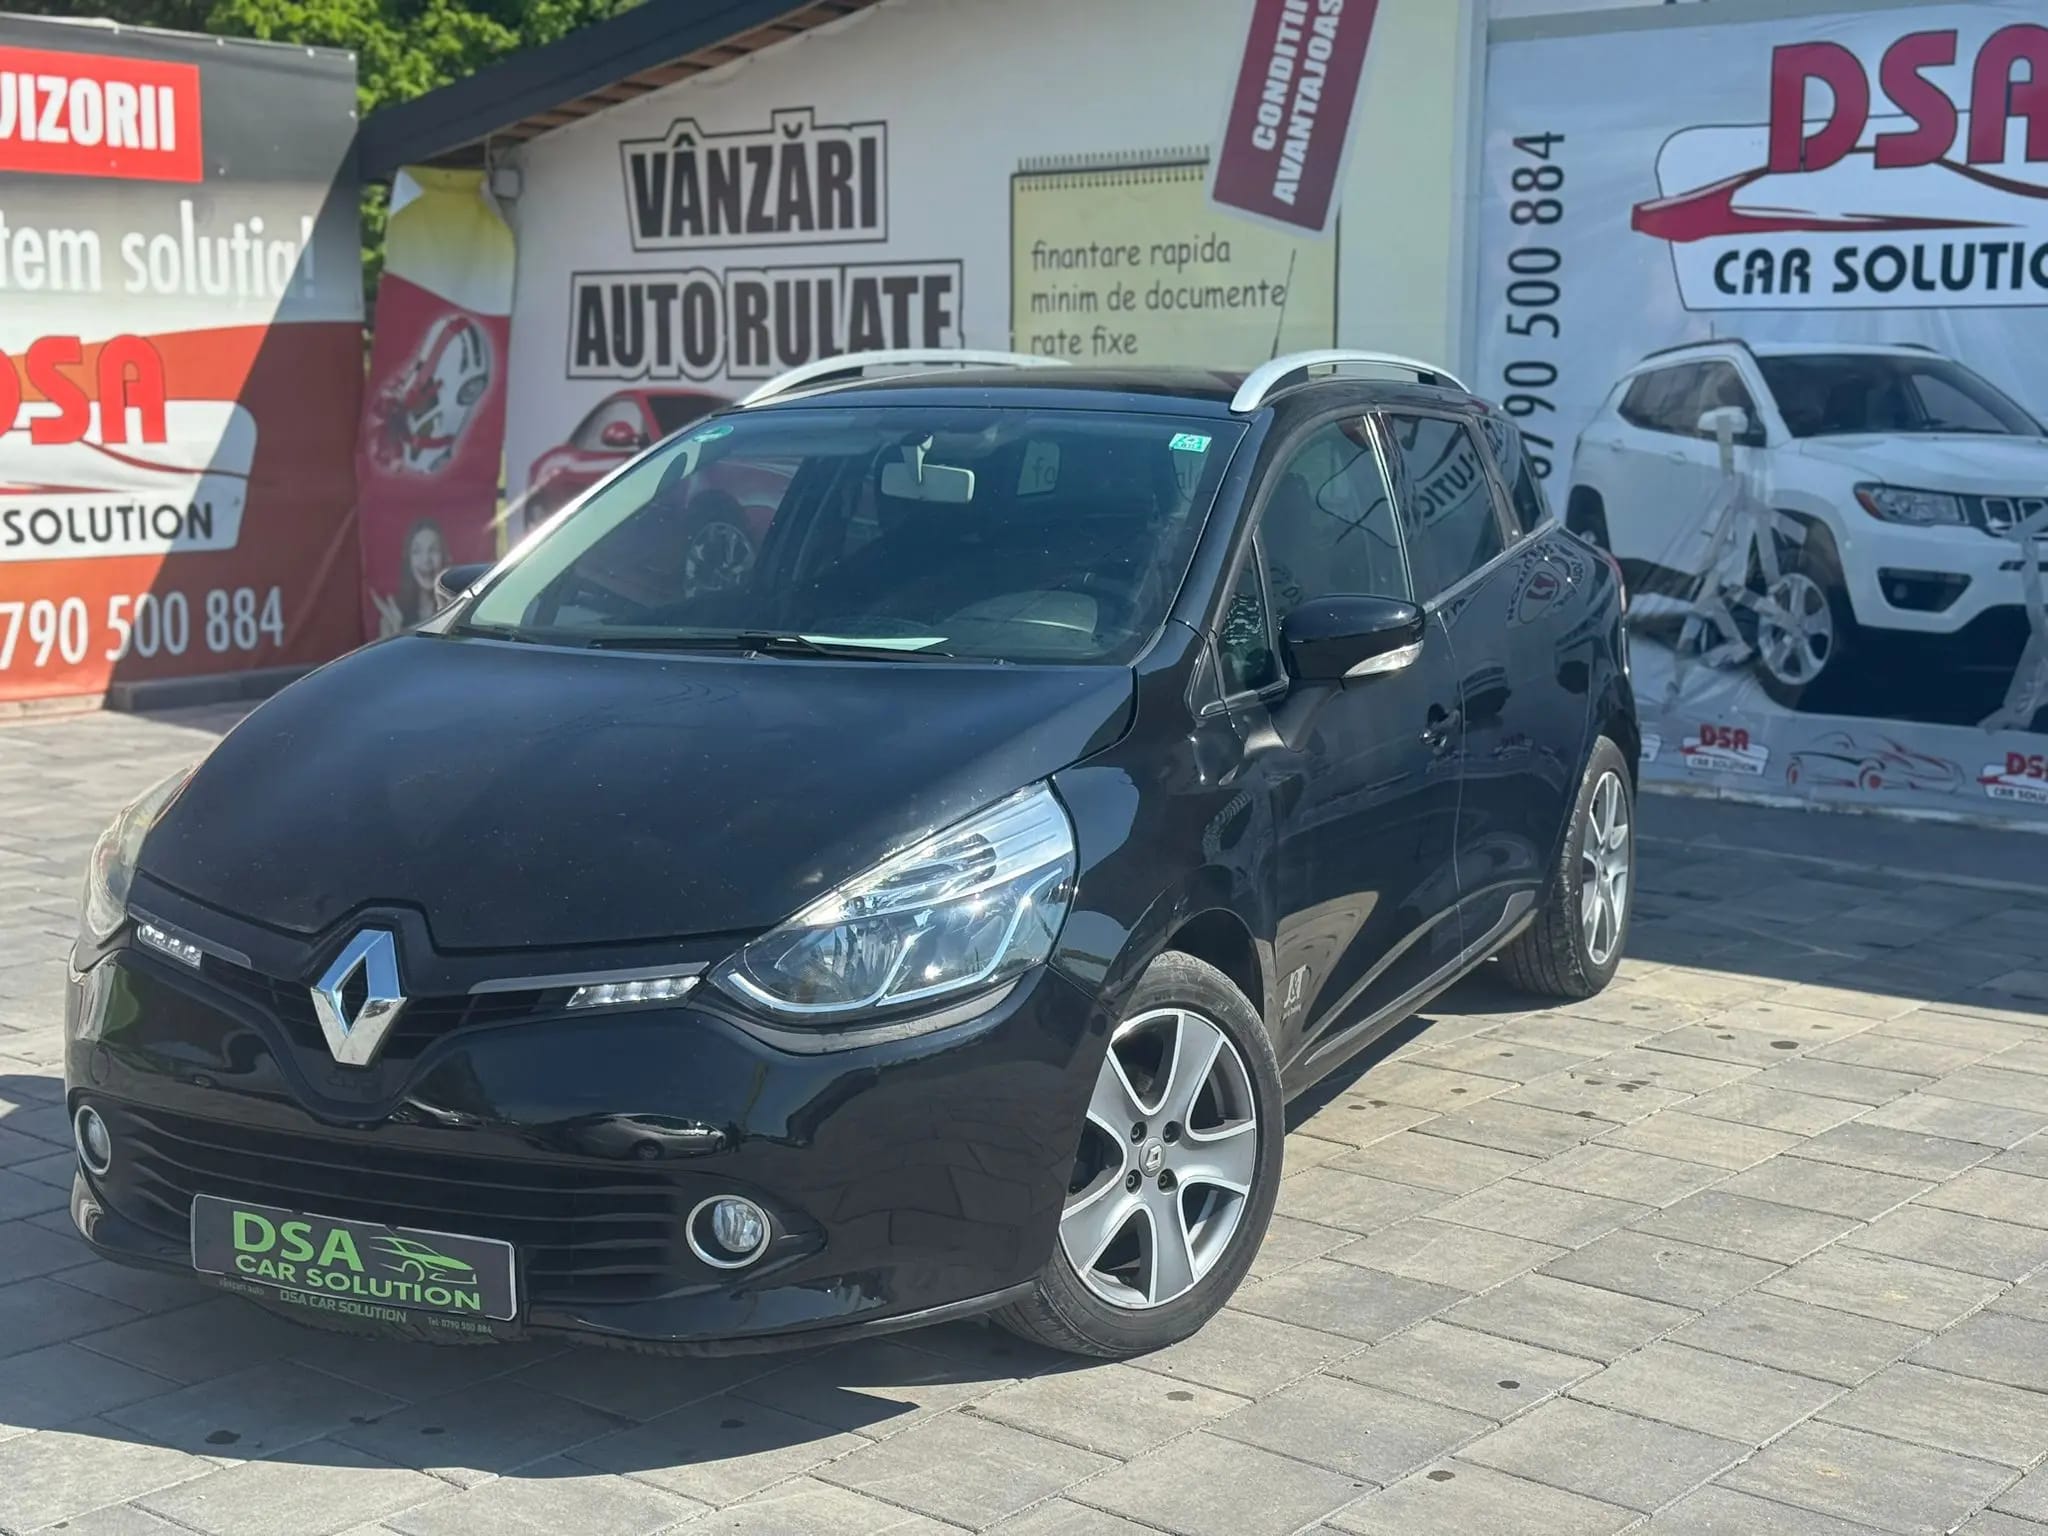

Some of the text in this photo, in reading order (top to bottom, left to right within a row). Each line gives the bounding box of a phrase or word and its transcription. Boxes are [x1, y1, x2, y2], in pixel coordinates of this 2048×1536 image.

[1768, 23, 2048, 174] DSA
[630, 123, 877, 239] VÂNZĂRI
[1510, 131, 1565, 226] 884
[1031, 232, 1231, 274] finantare rapida
[1713, 248, 1811, 295] CAR
[1030, 280, 1286, 314] minim de documente
[1506, 247, 1562, 339] 500
[576, 275, 952, 367] AUTO RULATE
[1030, 325, 1138, 356] rate fixe
[4, 503, 213, 545] SOLUTION
[105, 591, 190, 661] 500
[205, 586, 285, 651] 884
[1699, 724, 1749, 751] DSA
[2005, 752, 2048, 779] DS
[233, 1211, 365, 1272] DSA
[235, 1254, 481, 1311] CAR SOLUTION
[280, 1289, 408, 1324] DSA CAR SOLUTION
